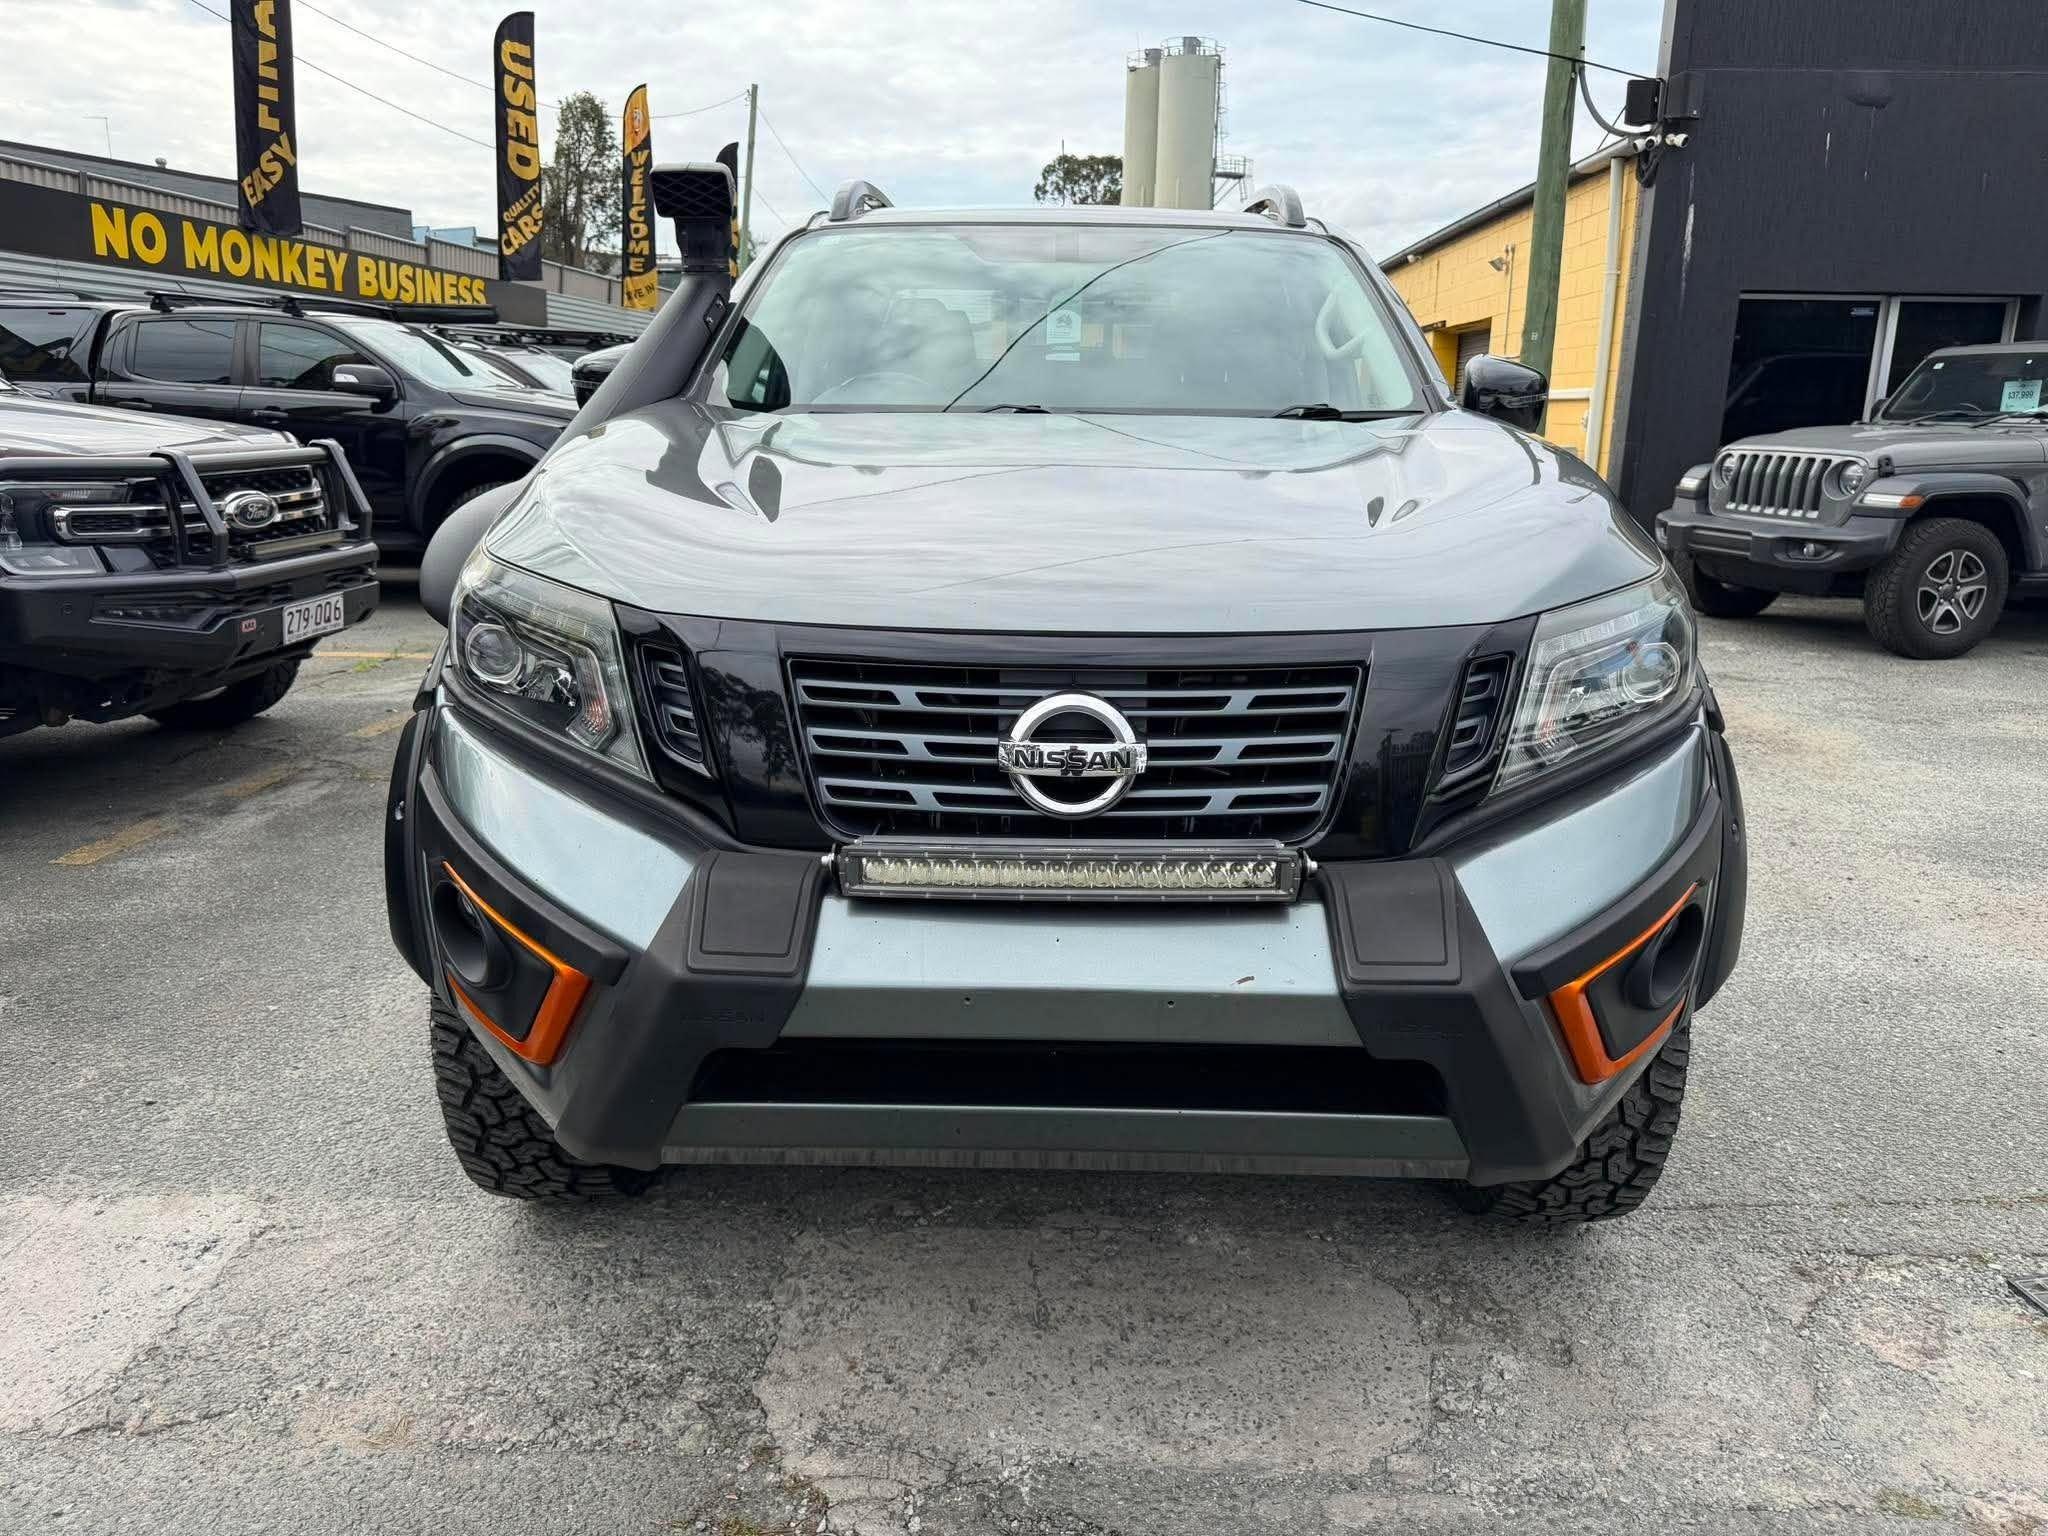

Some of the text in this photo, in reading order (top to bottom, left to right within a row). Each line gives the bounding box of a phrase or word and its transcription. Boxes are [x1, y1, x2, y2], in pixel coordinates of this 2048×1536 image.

[501, 39, 541, 181] USED
[241, 131, 297, 208] EASY
[501, 202, 544, 256] CARS
[503, 182, 540, 223] QUALITY
[628, 150, 650, 273] WELCOME
[91, 202, 487, 305] NO MONKEY BUSINESS
[246, 503, 269, 520] Ford
[1013, 749, 1131, 771] NISSAN
